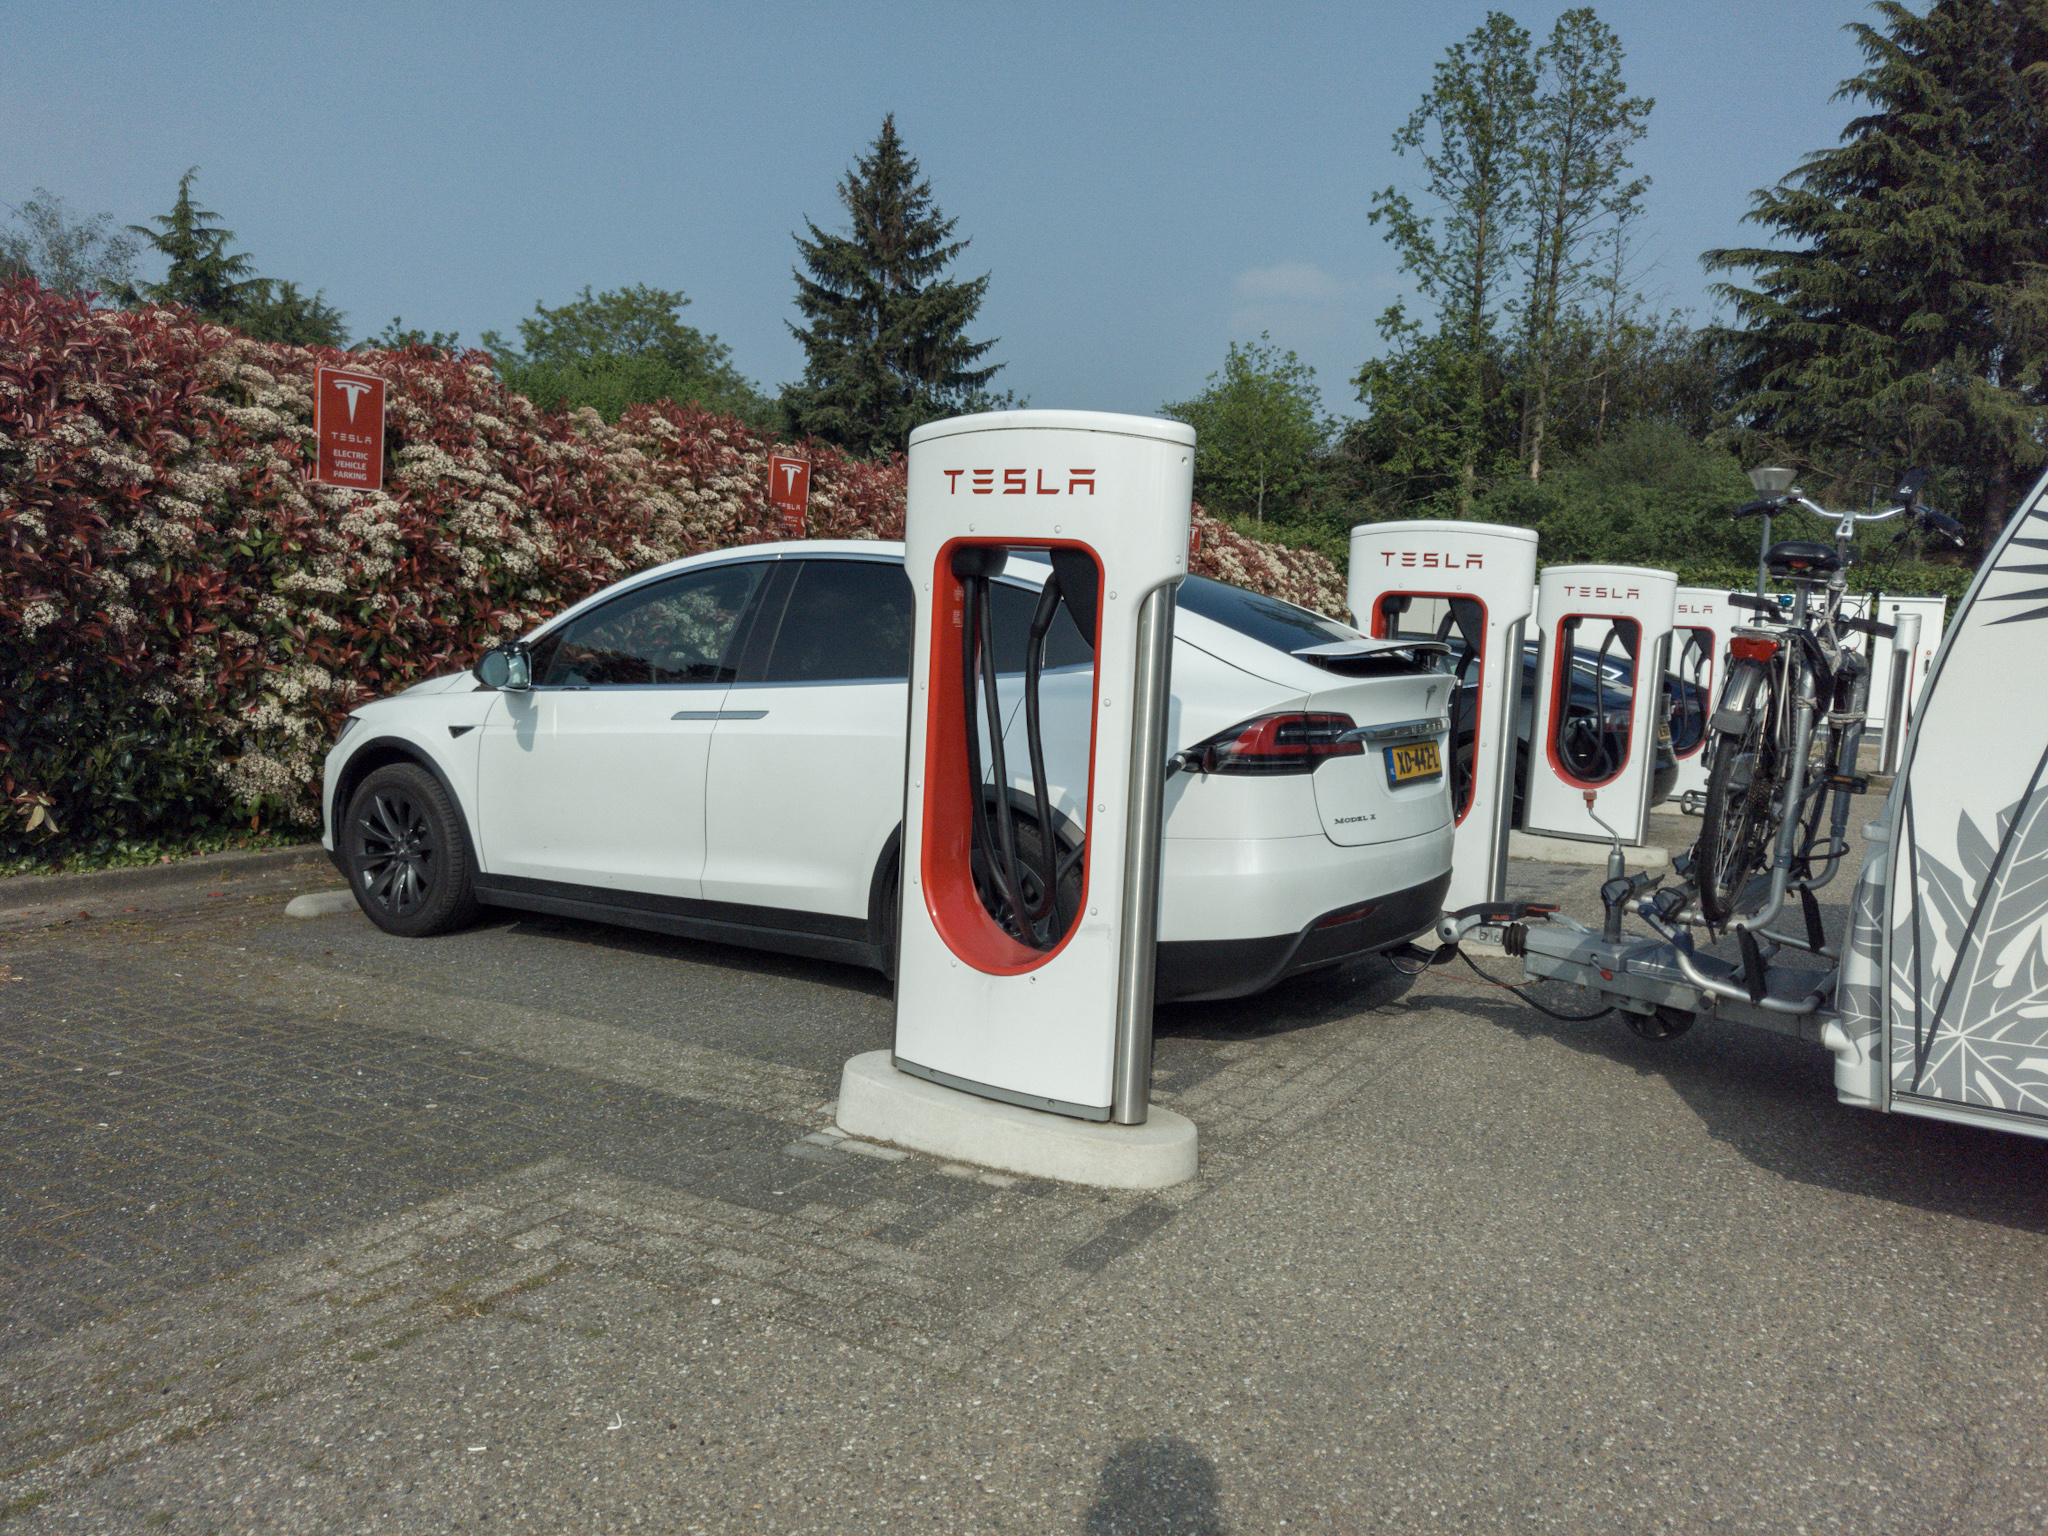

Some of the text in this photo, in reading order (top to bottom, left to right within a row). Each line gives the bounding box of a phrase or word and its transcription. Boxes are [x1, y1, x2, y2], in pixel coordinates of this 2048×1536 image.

[331, 431, 372, 445] TESLA
[333, 449, 369, 460] ELECTRIC
[335, 460, 367, 471] VEHICLE
[333, 470, 367, 481] PARKING
[943, 469, 1096, 496] TESLA
[1380, 552, 1483, 569] TESLA
[1564, 586, 1640, 600] TESLA
[1678, 604, 1713, 614] SLA
[1334, 815, 1369, 824] MODEL
